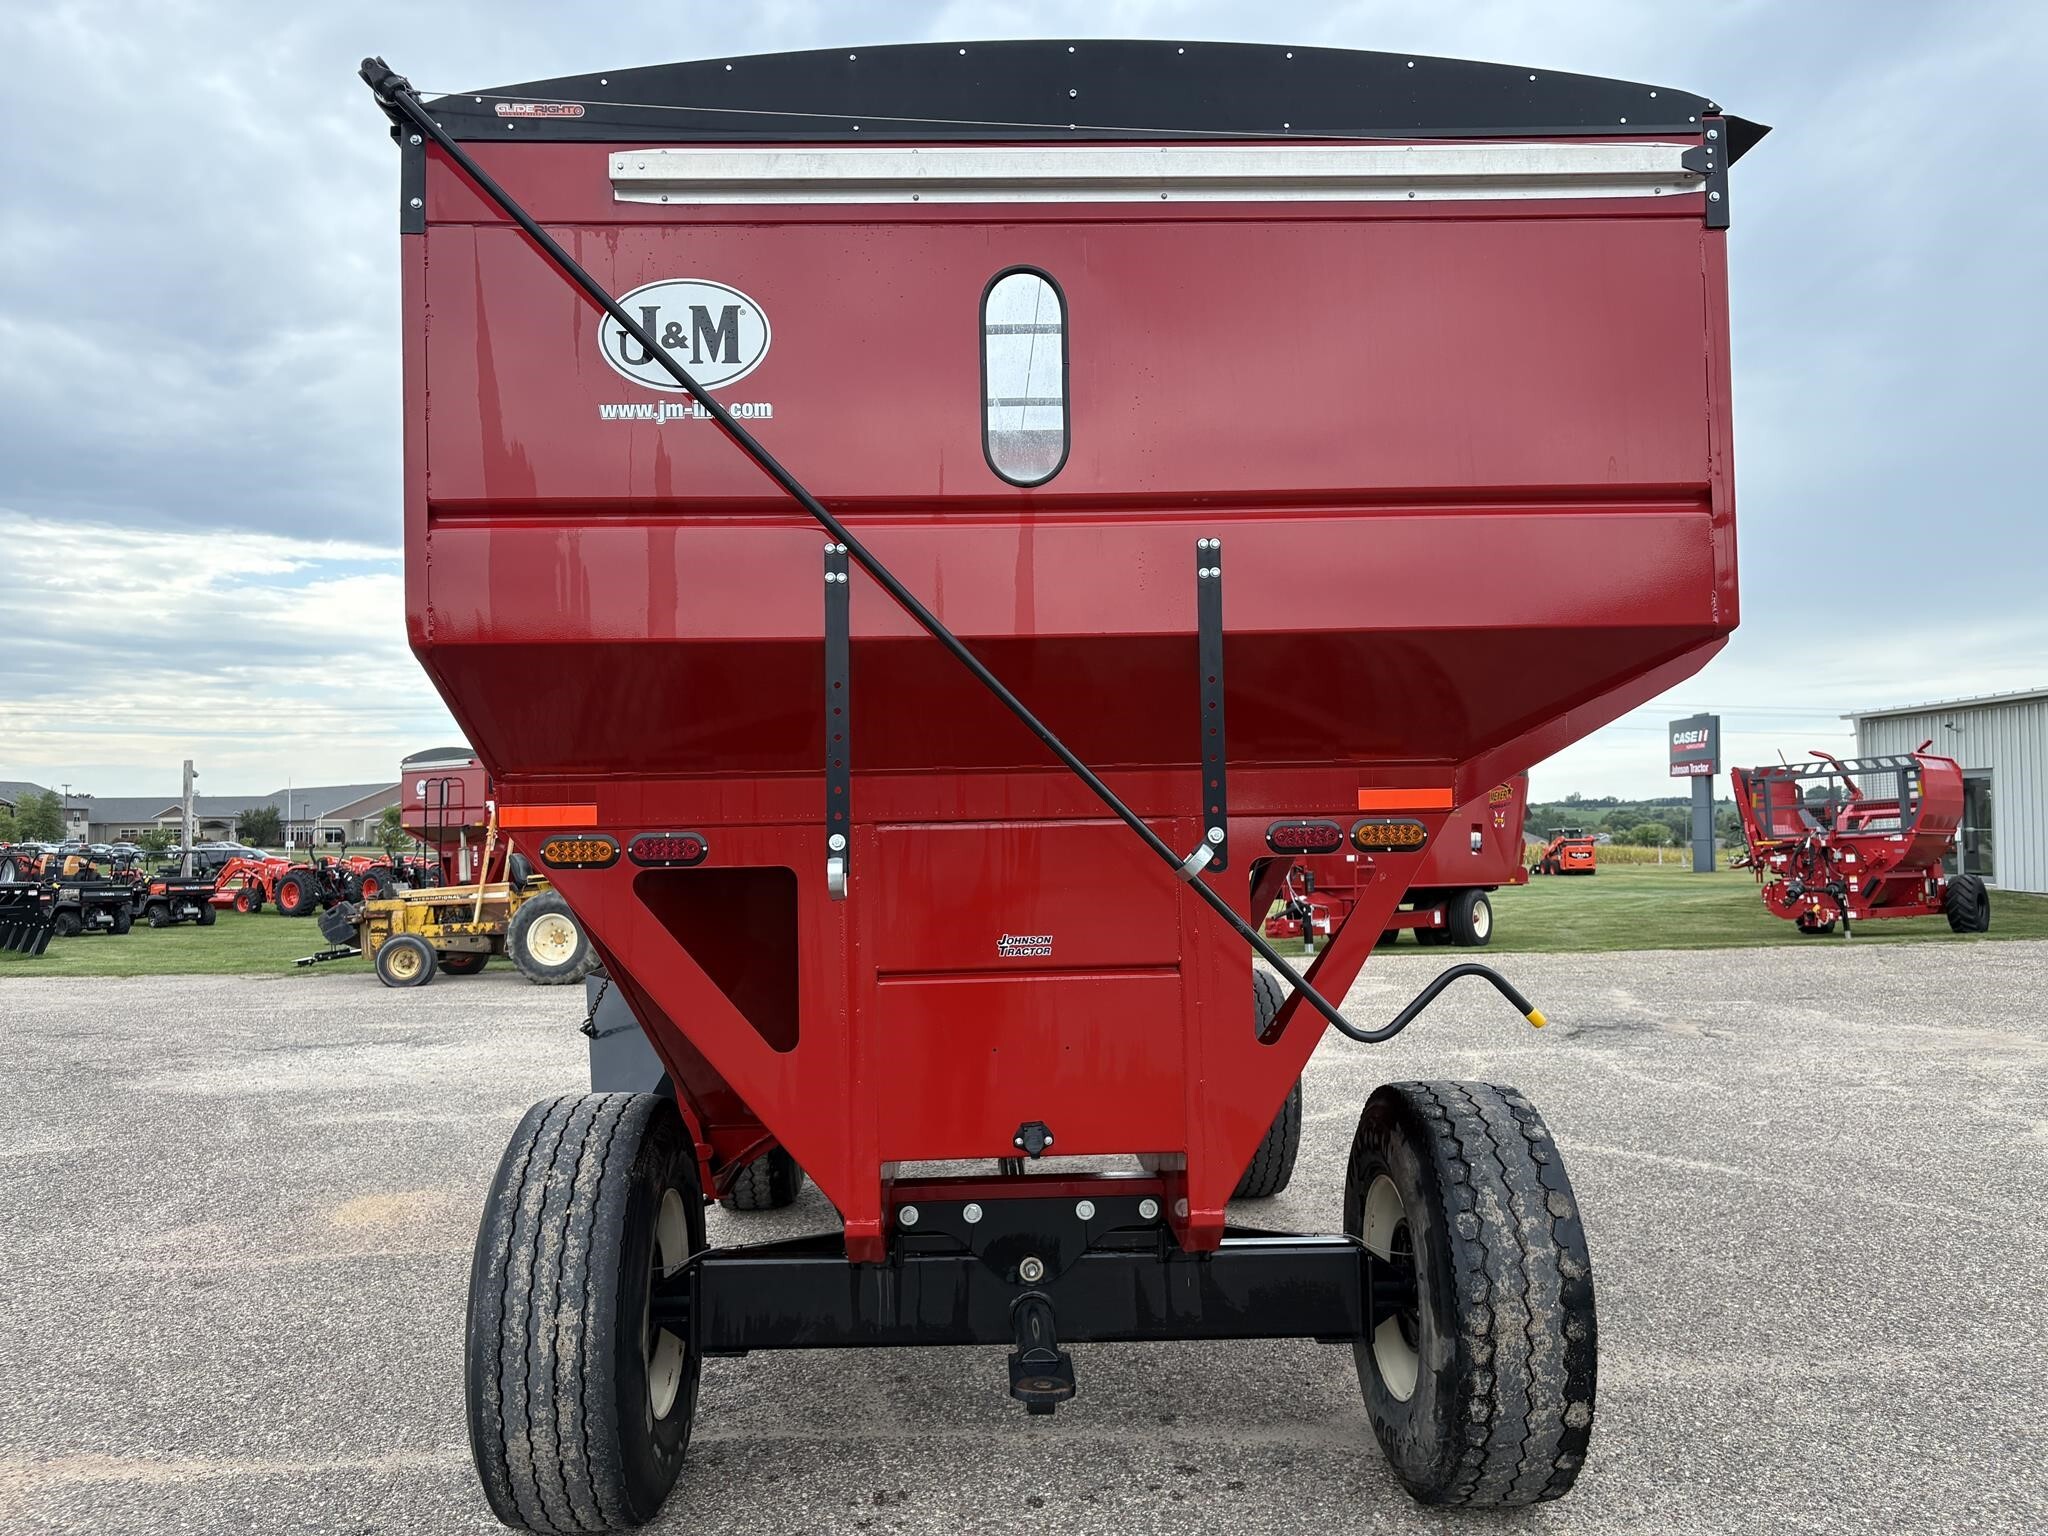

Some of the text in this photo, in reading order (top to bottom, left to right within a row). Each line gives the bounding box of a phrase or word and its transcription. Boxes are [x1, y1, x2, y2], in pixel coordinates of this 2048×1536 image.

[599, 401, 772, 424] www.jm-incom
[1673, 731, 1698, 745] CASE
[1690, 763, 1709, 773] Tractor
[997, 934, 1053, 945] JOHNSON
[998, 945, 1052, 957] TRACTOR
